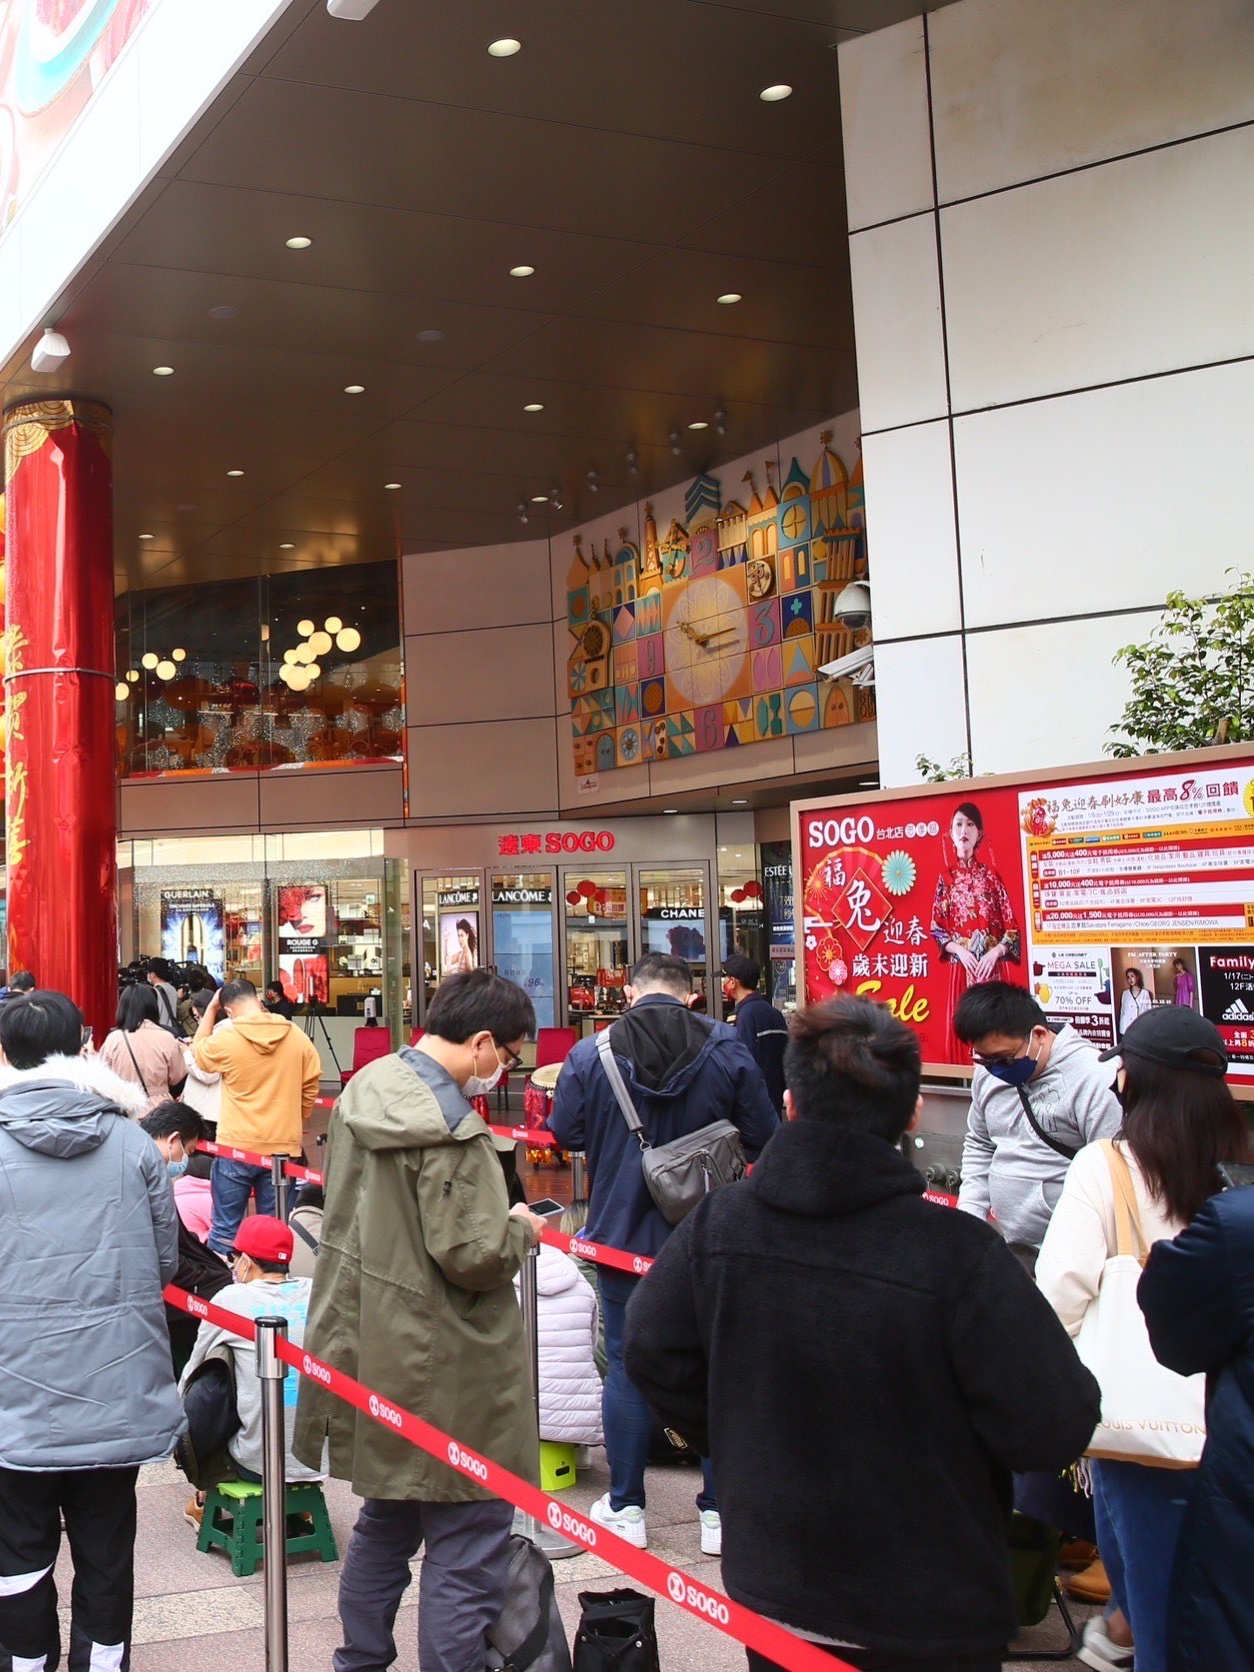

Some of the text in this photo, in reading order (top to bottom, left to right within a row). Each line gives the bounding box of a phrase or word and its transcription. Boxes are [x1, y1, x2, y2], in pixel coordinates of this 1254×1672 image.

[808, 816, 874, 848] SOGO
[876, 826, 904, 840] 台北店
[498, 831, 615, 855] 遠東 SOGO
[764, 865, 788, 877] ESTÉE
[824, 858, 846, 888] 福
[164, 890, 209, 899] GUERLAIN
[439, 891, 471, 904] LANCÔME
[492, 890, 545, 902] LANCÔME
[846, 880, 881, 931] 兔
[884, 915, 928, 946] 迎春
[286, 938, 319, 946] ROUGE G
[852, 953, 928, 977] 歲末迎新
[1047, 961, 1096, 970] MEGA SALE
[1055, 996, 1092, 1005] 70% OFF
[1222, 1012, 1254, 1021] adidas
[577, 1243, 596, 1256] SOGO
[193, 1300, 208, 1316] SOGO
[311, 1364, 331, 1385] SOGO
[379, 1406, 402, 1427] SOGO
[1136, 1419, 1206, 1435] VUITTON
[460, 1450, 488, 1480] SOGO
[562, 1512, 596, 1546] SOGO
[686, 1585, 729, 1625] SOGO
